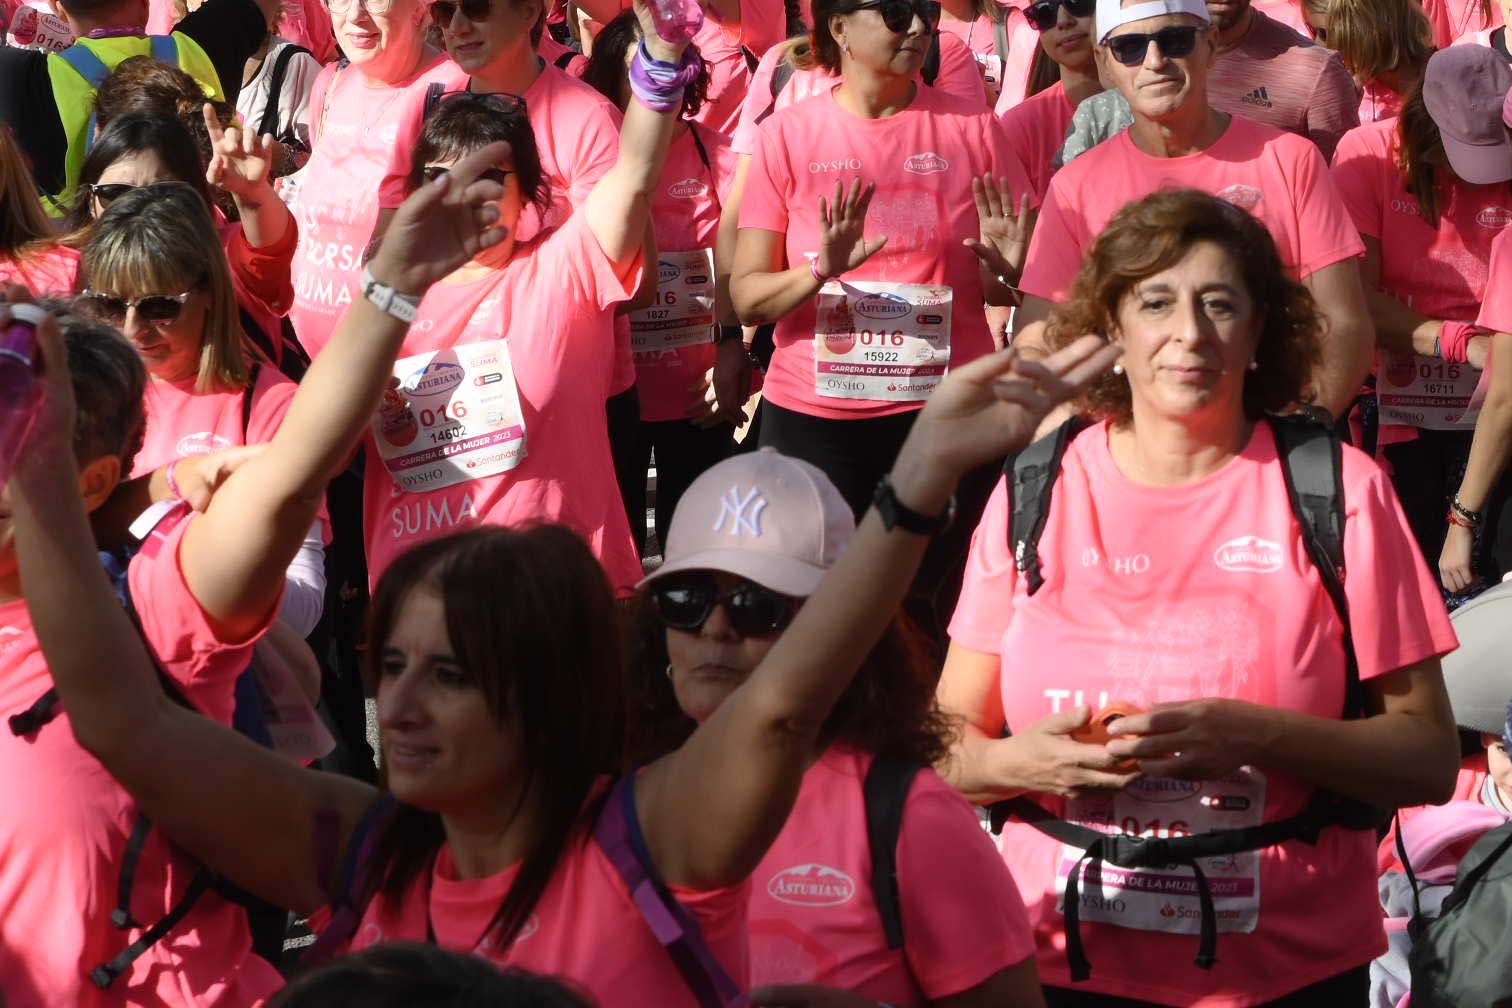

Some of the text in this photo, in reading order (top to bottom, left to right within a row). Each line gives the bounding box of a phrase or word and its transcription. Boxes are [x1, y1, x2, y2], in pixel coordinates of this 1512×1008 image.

[809, 158, 862, 174] OYSHO
[1391, 199, 1418, 215] OYS
[655, 291, 676, 306] 16
[859, 303, 908, 313] ASTURIANA
[860, 329, 904, 346] 016
[864, 352, 899, 362] 15922
[830, 364, 865, 373] CARRERA
[866, 366, 877, 374] DE
[1419, 365, 1461, 380] 016
[827, 379, 937, 393] OYSHO Santander
[1423, 383, 1455, 394] 16711
[419, 400, 468, 428] 016
[430, 424, 467, 444] 14602
[400, 452, 439, 467] CARRERA
[439, 447, 450, 457] DE
[451, 444, 462, 454] LA
[462, 436, 491, 451] MUJER
[402, 448, 521, 488] OYSHO Santander
[392, 492, 479, 538] SUMA
[1222, 549, 1283, 564] ASTURIANA
[1121, 816, 1191, 839] 016
[777, 877, 848, 897] ASTURIANA
[1128, 877, 1144, 887] DE
[1147, 879, 1162, 888] LA
[1165, 881, 1198, 891] MUJE
[1082, 896, 1127, 913] YSHO
